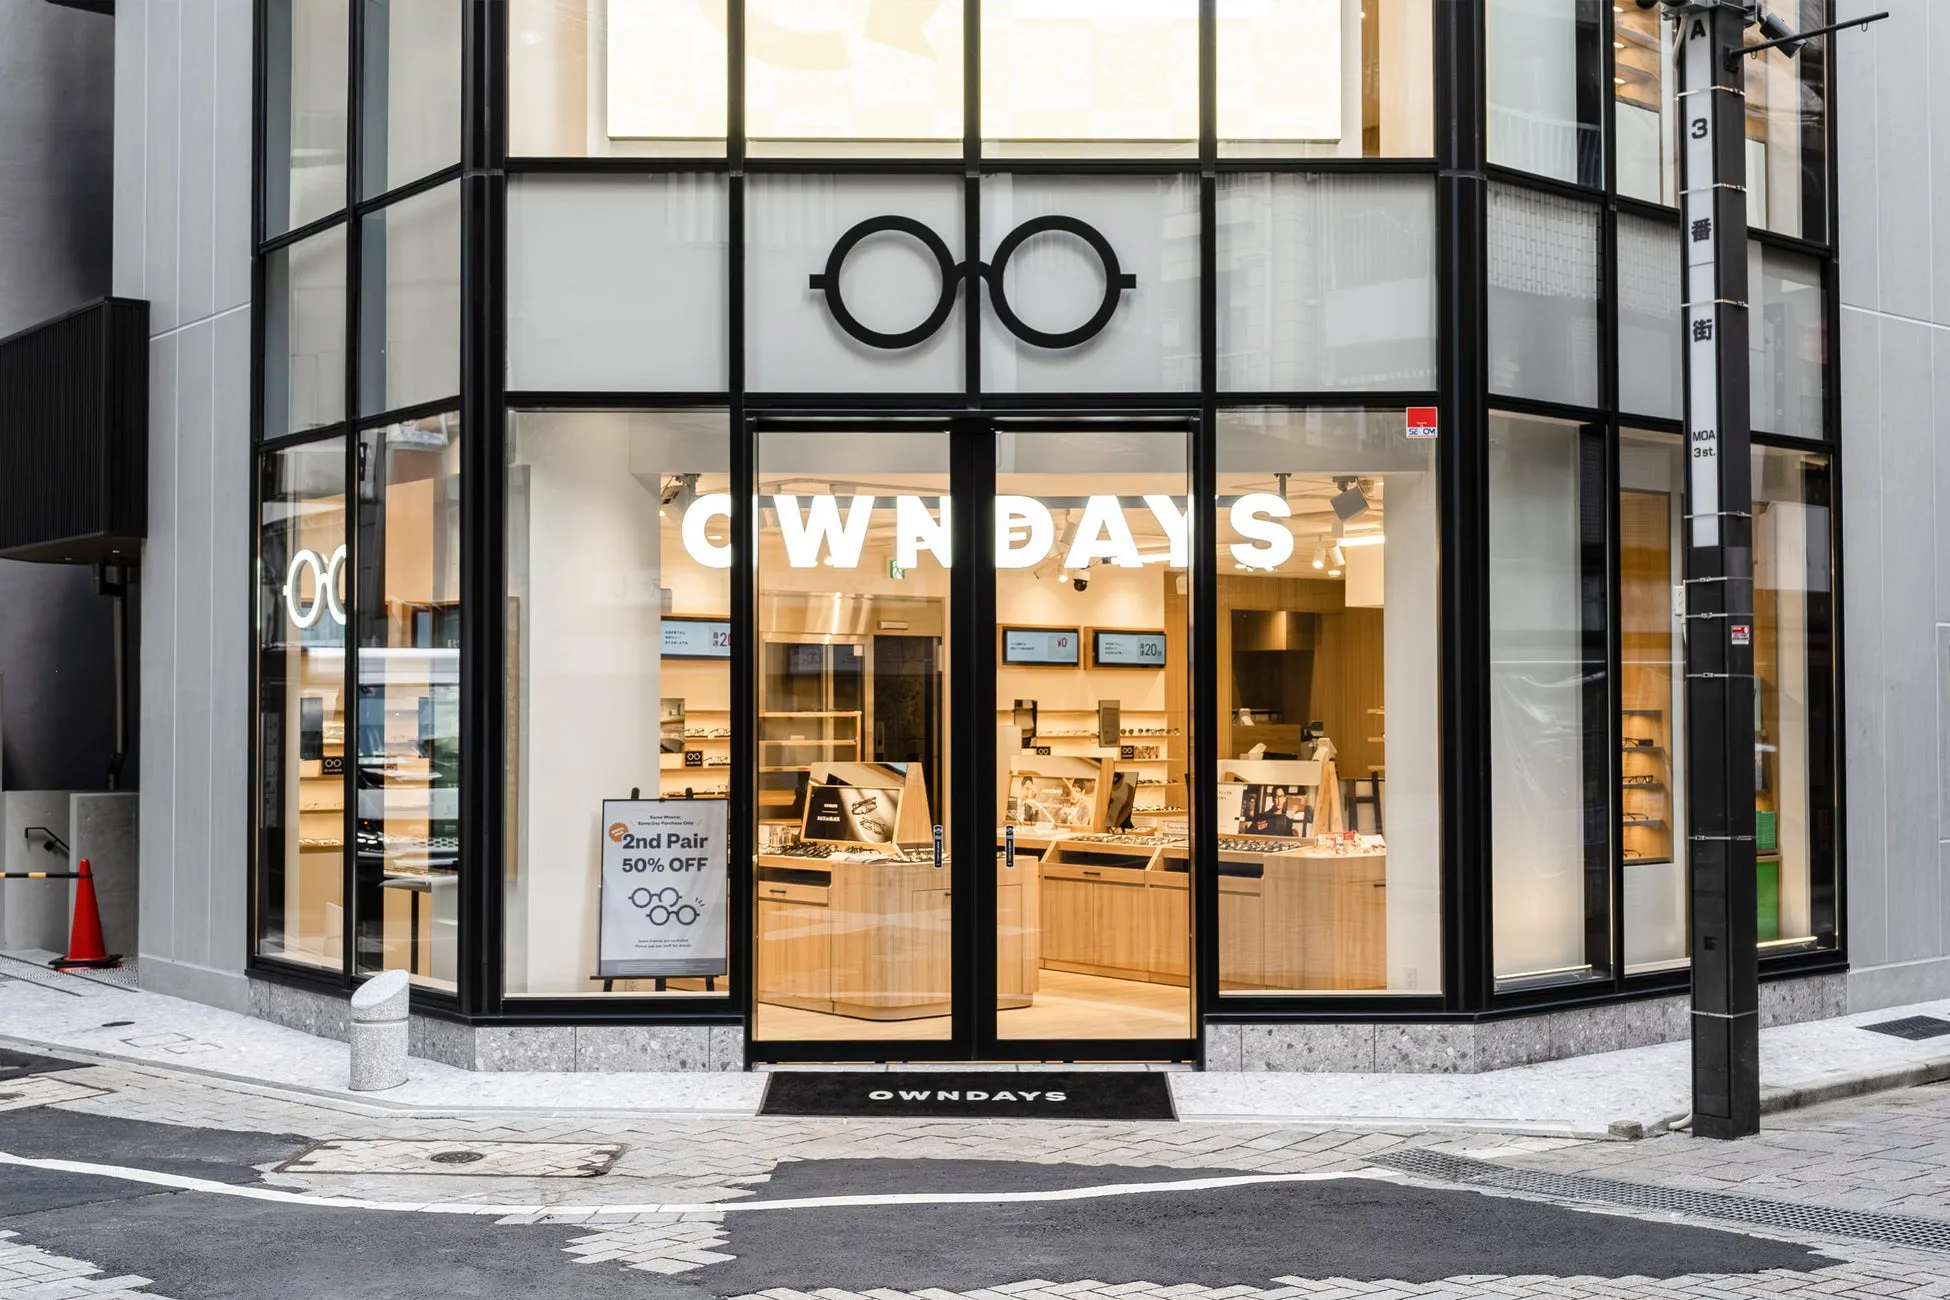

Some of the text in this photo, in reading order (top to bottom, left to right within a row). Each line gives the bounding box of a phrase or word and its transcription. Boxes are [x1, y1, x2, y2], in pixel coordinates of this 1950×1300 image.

[1692, 429, 1715, 442] MOA
[622, 833, 708, 849] 2nd Pair
[622, 857, 708, 873] 50% OFF
[868, 1090, 1067, 1101] OWNDAYS
